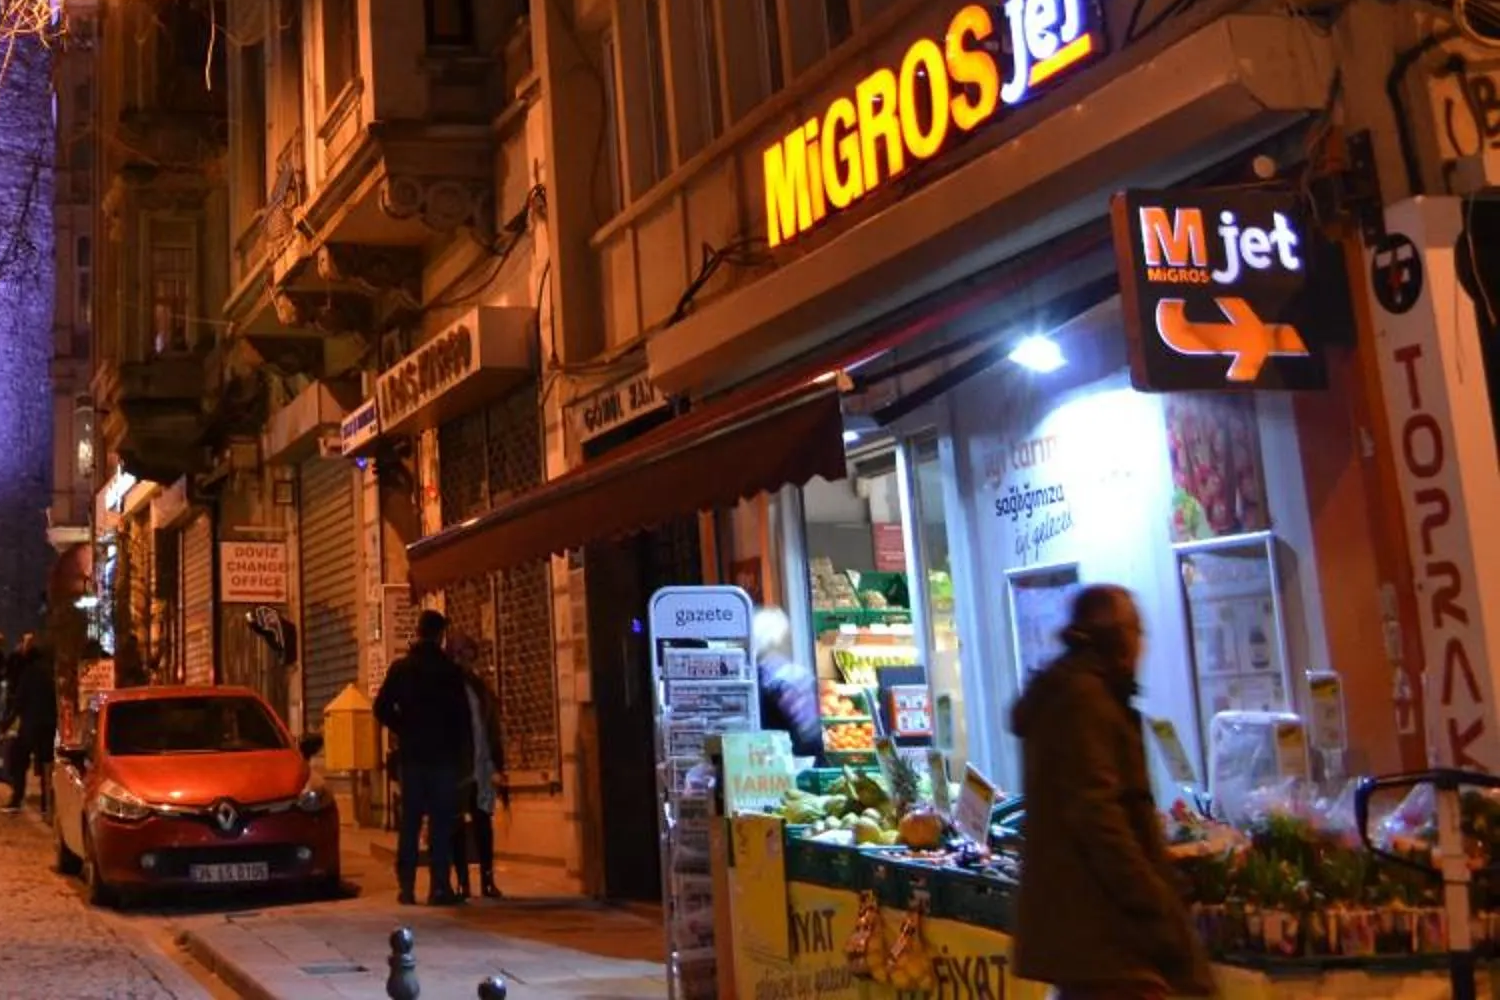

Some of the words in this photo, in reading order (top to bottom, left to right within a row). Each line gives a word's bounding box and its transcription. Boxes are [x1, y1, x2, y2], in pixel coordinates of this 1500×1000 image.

[1139, 207, 1208, 267] M
[1211, 210, 1300, 284] jet
[226, 561, 289, 573] CHANGE
[675, 607, 734, 627] gazete
